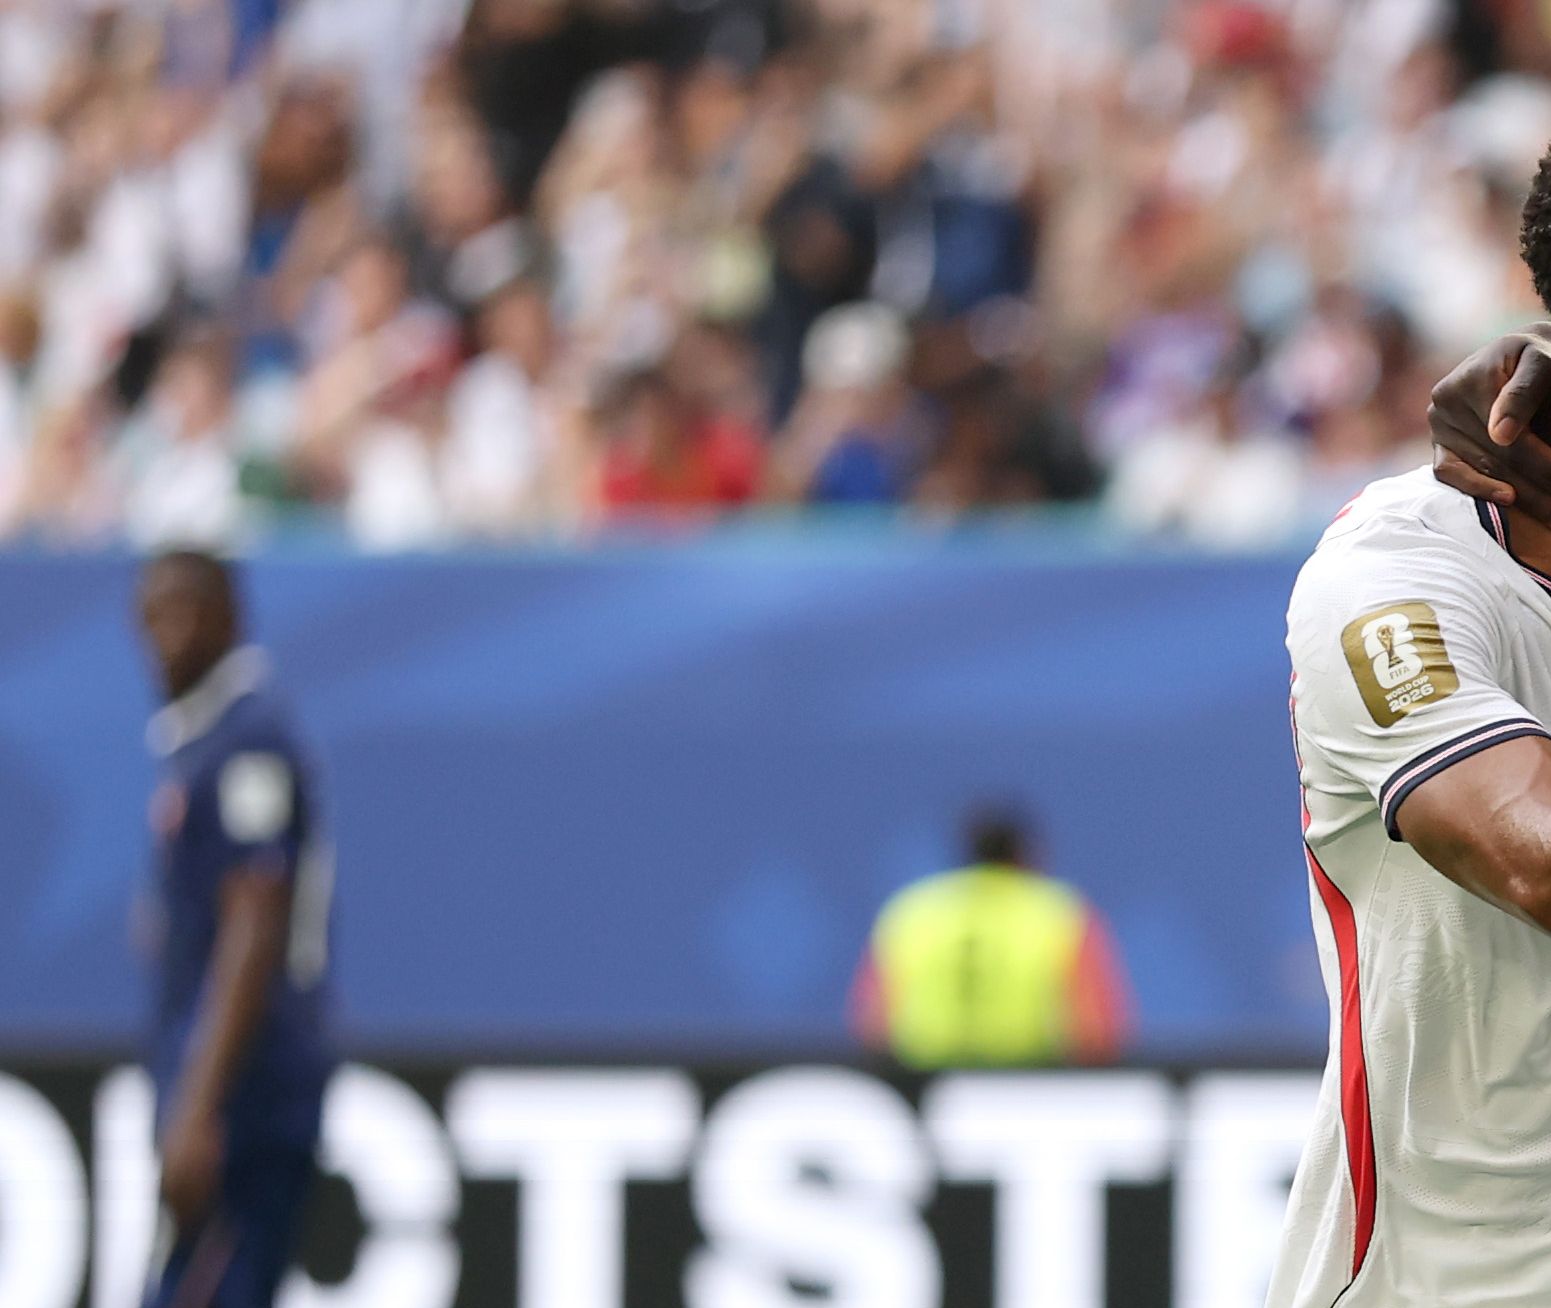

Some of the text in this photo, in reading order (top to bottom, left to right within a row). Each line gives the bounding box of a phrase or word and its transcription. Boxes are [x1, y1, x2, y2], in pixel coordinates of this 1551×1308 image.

[1389, 666, 1410, 680] FIFA
[1385, 675, 1430, 701] WORLD CUP
[1388, 683, 1435, 713] 2026
